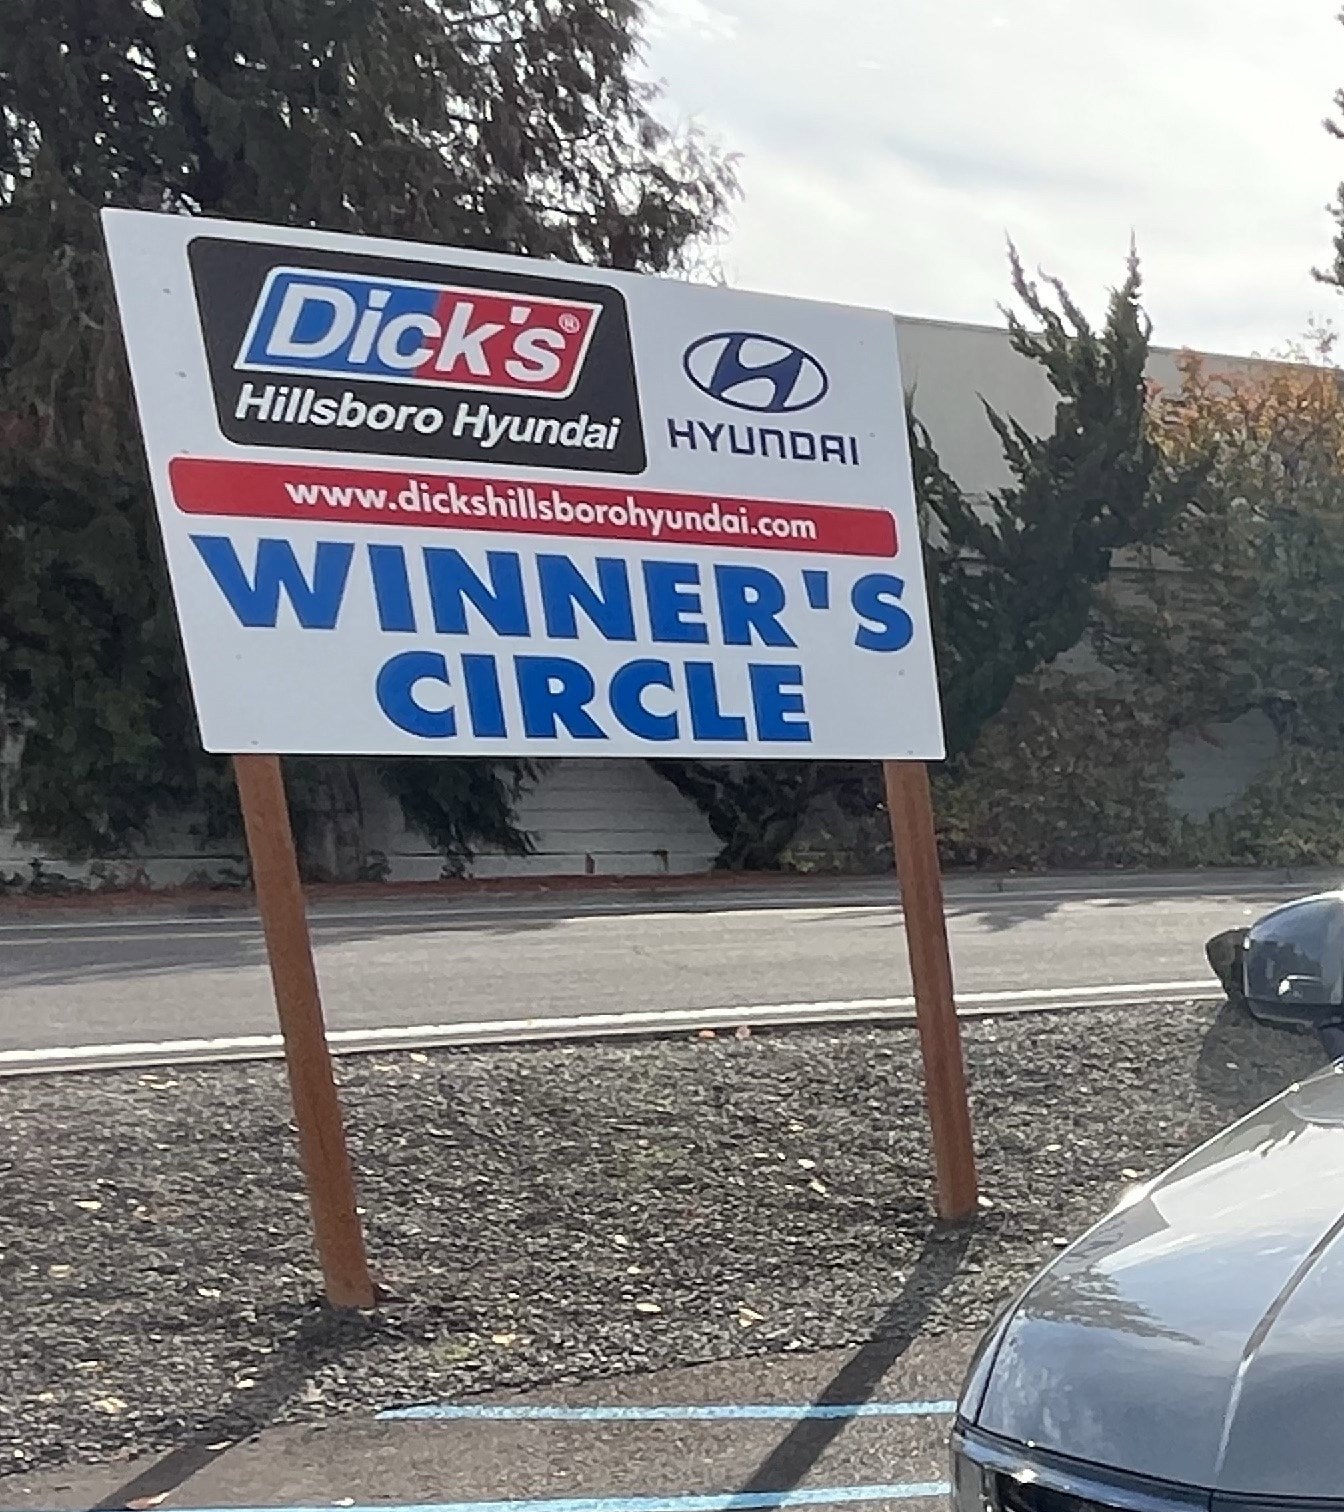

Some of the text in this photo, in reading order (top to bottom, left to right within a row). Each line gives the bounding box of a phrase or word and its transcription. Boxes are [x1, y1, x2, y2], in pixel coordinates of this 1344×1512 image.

[264, 282, 567, 384] Dick's
[234, 383, 622, 452] Hillsboro Hyundai
[668, 417, 860, 467] HYUNDAI
[285, 480, 818, 541] www.dickshillsborohyundai.com
[189, 533, 915, 653] WINNER'S
[375, 650, 814, 743] CIRCLE
